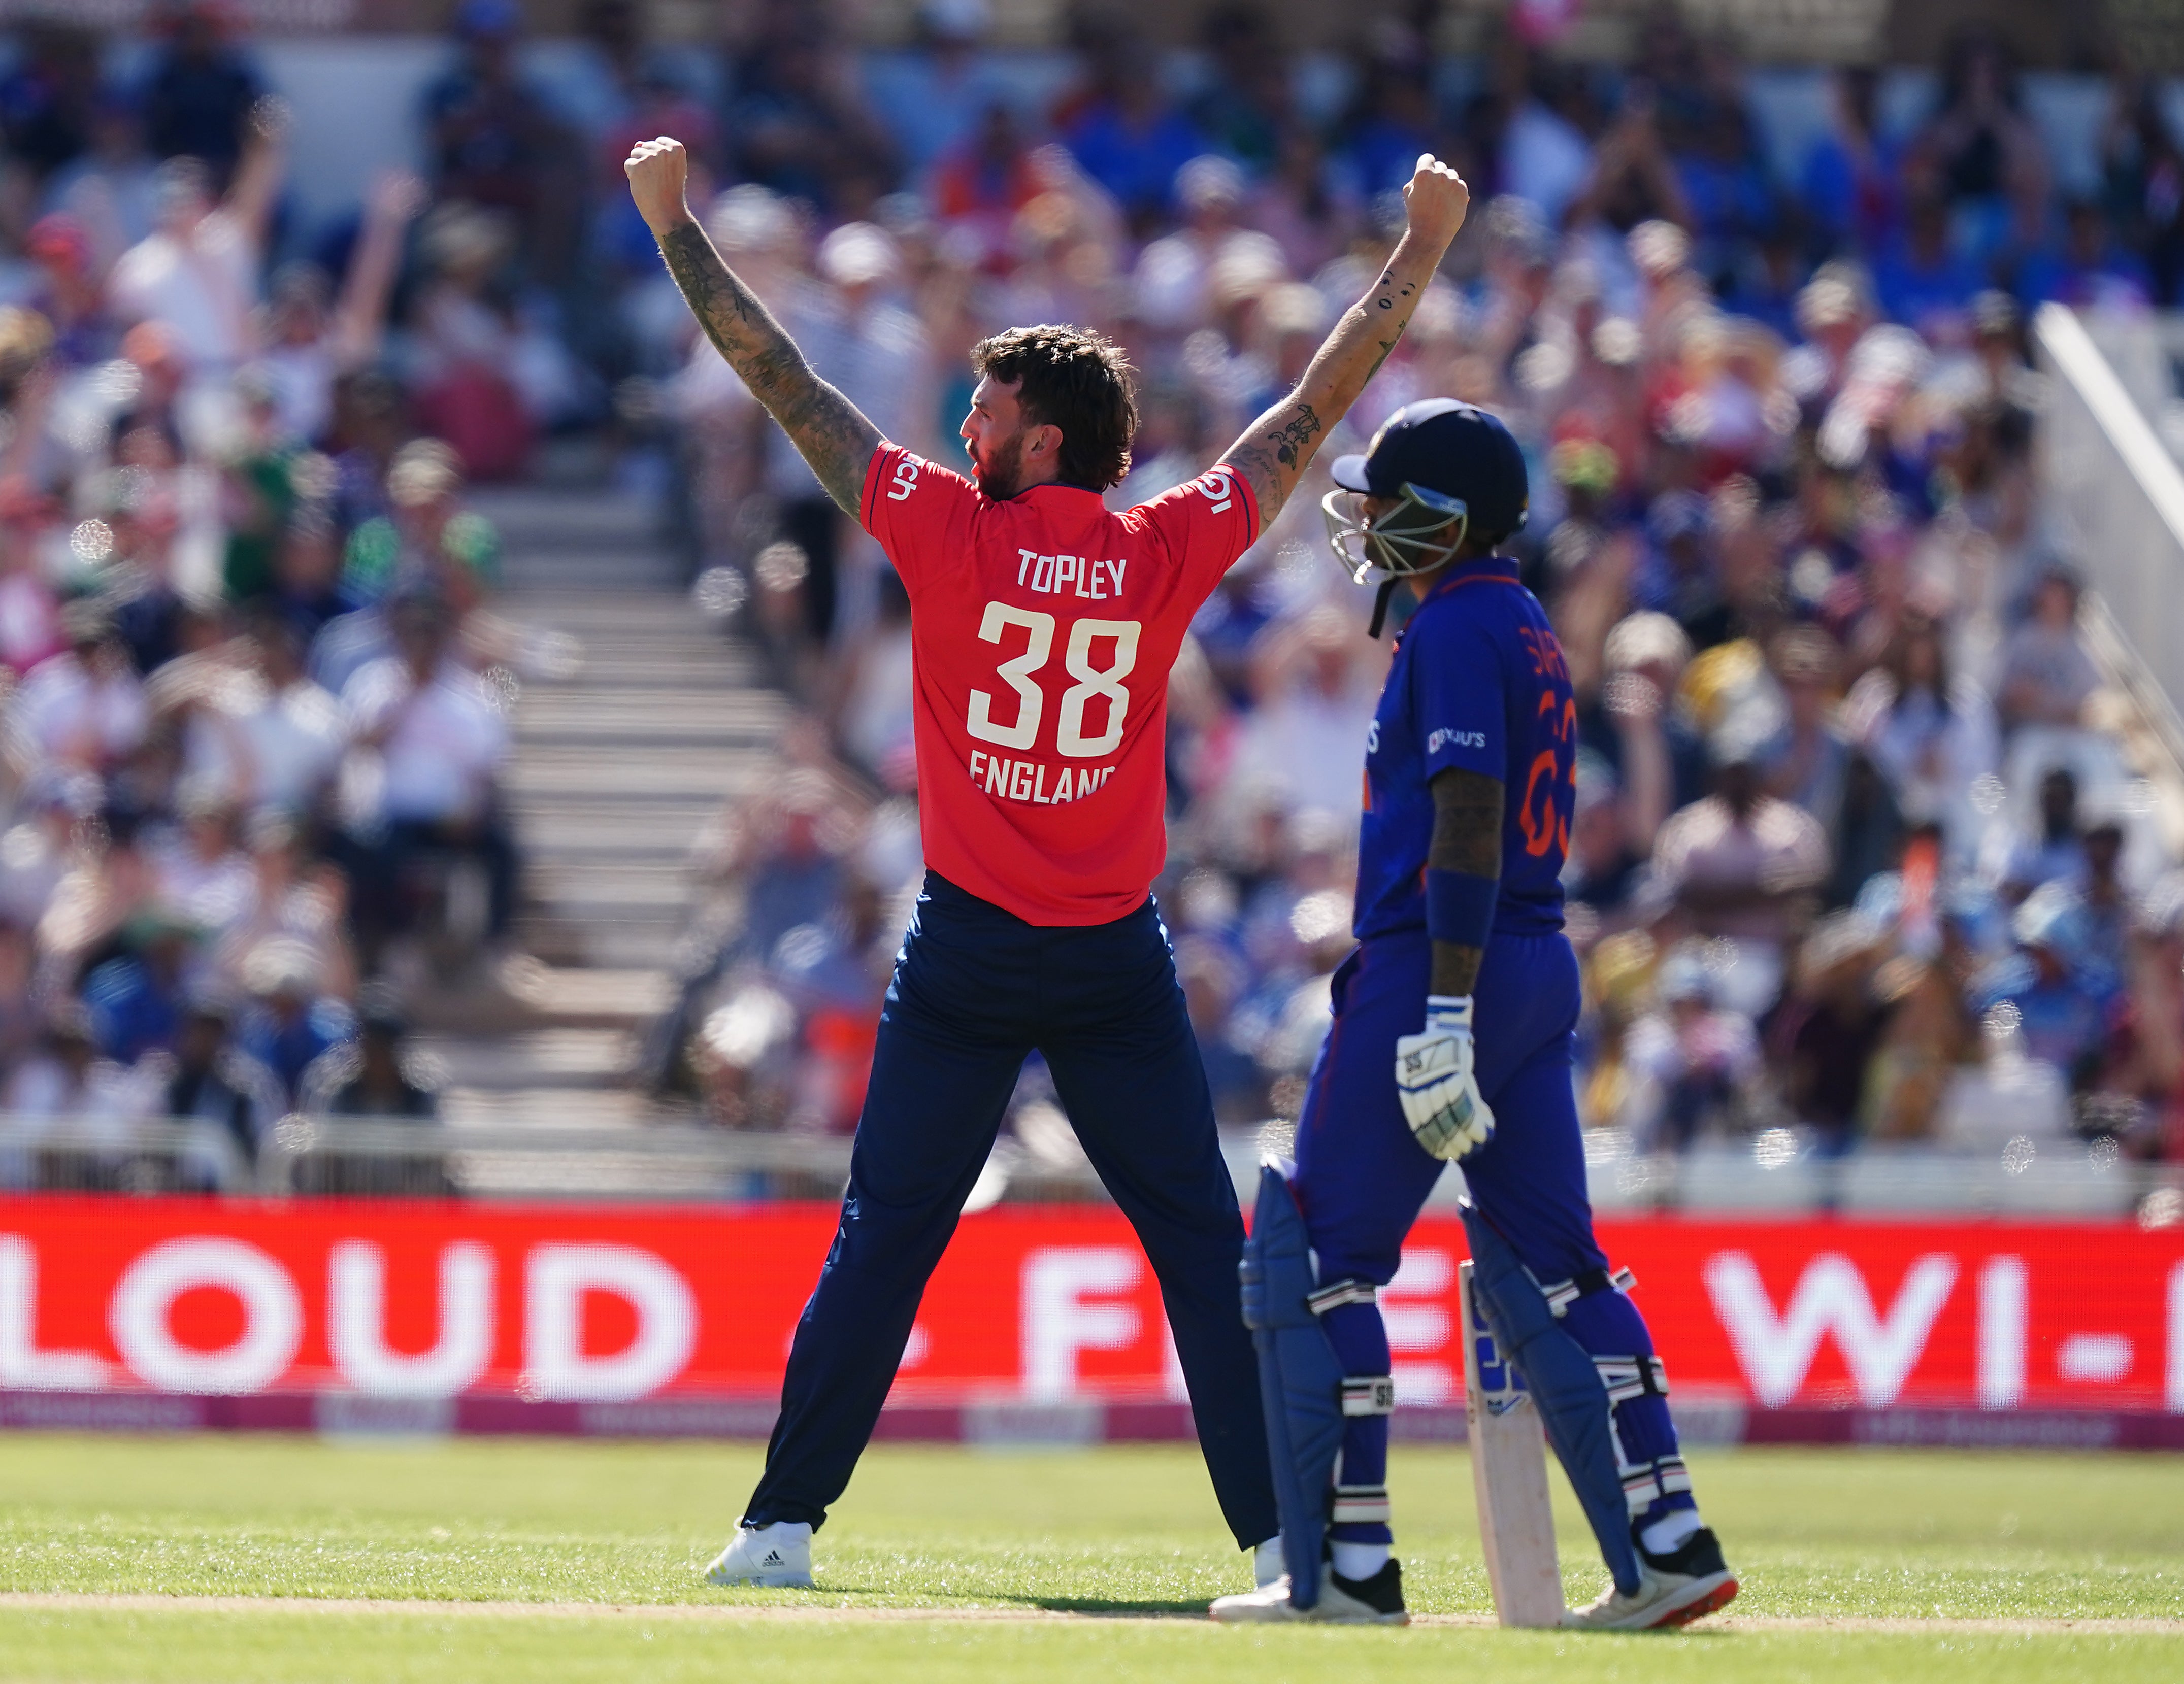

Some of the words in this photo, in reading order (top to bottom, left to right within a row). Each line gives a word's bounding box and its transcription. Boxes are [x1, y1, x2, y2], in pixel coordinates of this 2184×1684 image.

[1017, 549, 1127, 599] TOPLEY
[967, 600, 1142, 757] 38
[0, 1232, 699, 1404] LOUD
[1701, 1249, 2184, 1417] WI-
